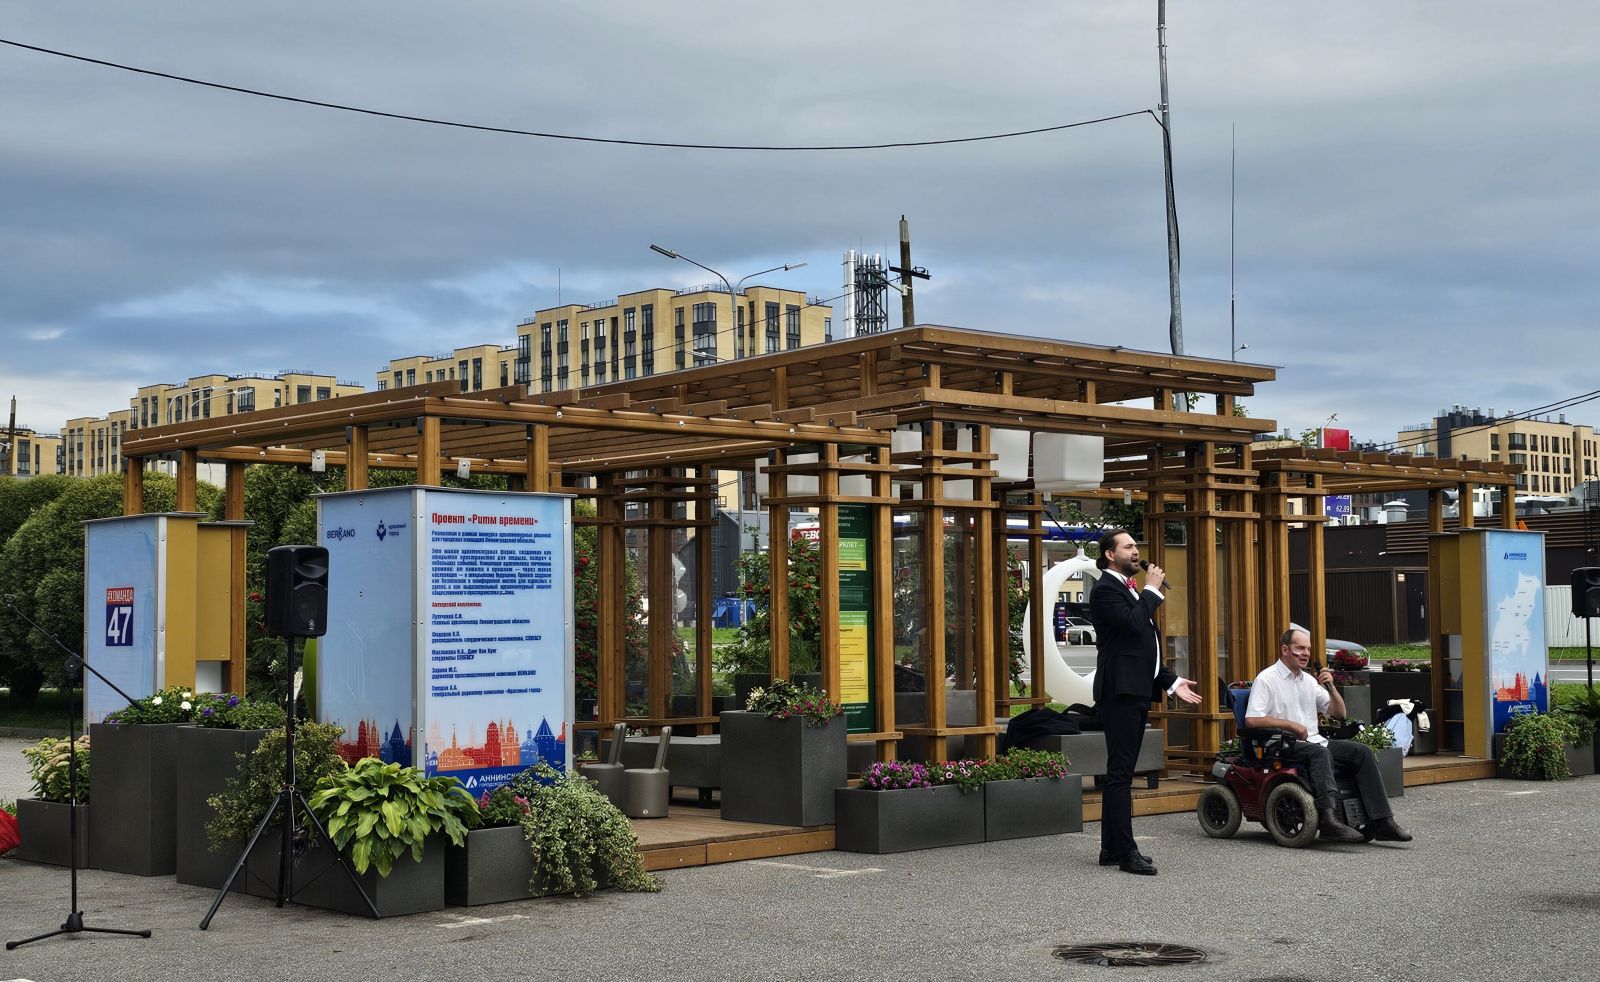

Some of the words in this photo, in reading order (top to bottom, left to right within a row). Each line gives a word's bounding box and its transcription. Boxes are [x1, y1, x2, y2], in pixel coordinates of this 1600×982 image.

[432, 513, 464, 525] Проект
[468, 514, 496, 524] «Ритм
[499, 516, 538, 526] времени»
[108, 607, 132, 644] 47
[480, 774, 516, 782] АННИНСК
